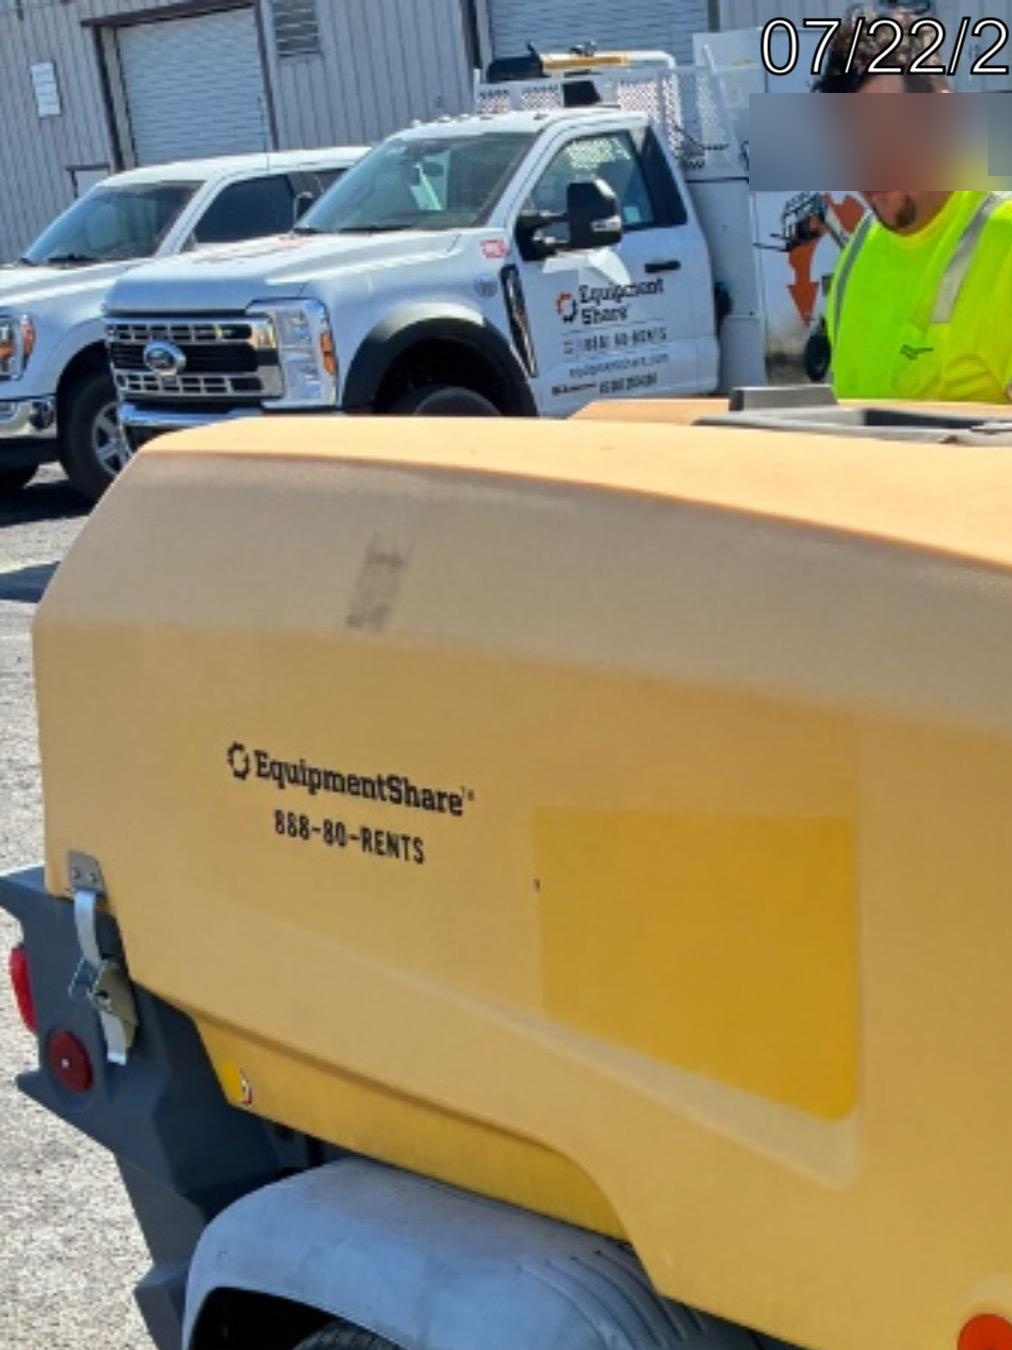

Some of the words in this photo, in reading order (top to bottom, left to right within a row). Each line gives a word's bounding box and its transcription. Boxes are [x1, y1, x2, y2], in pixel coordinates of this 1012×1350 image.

[581, 306, 627, 325] Share
[254, 750, 463, 817] EquipmentShare
[274, 809, 425, 865] 888-80-RENTS
